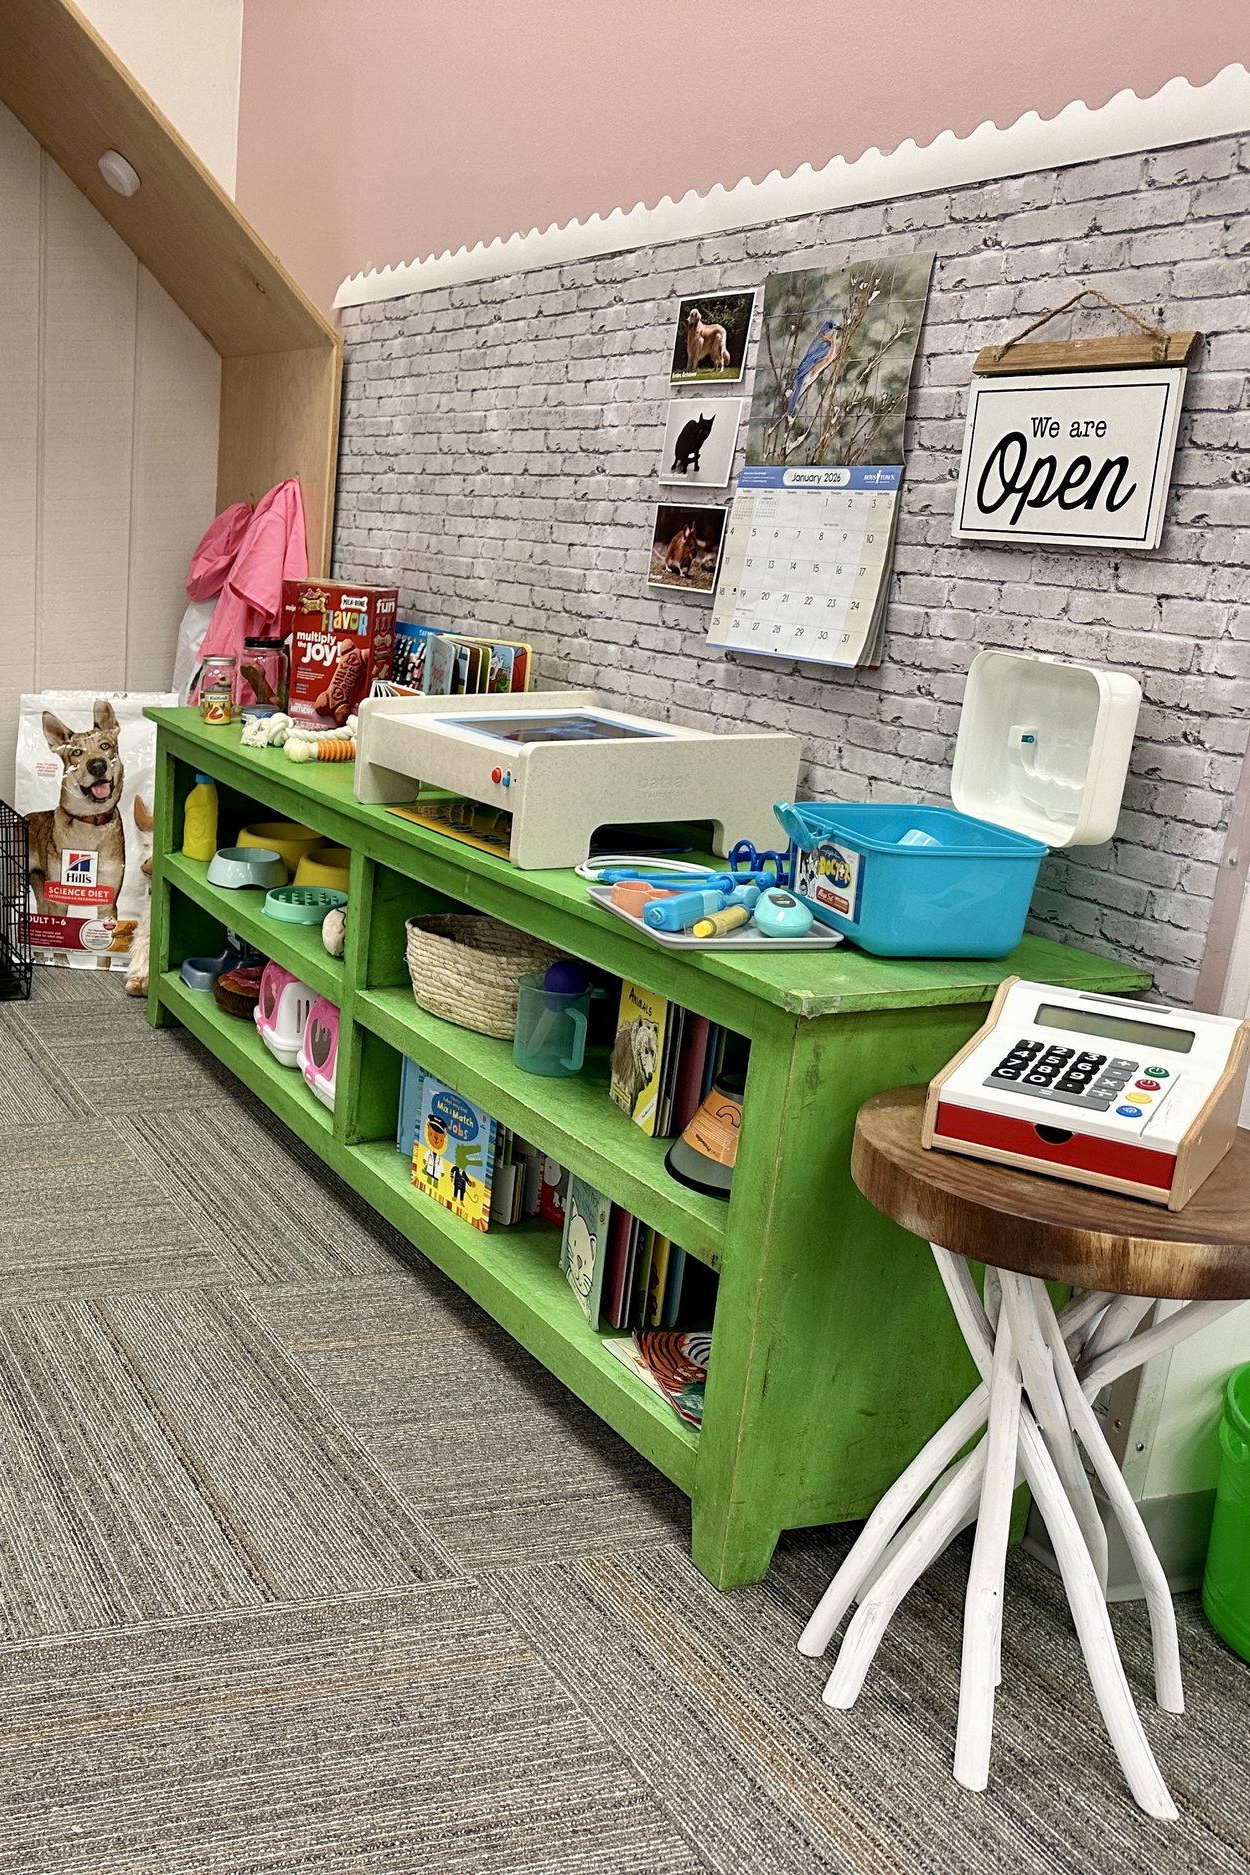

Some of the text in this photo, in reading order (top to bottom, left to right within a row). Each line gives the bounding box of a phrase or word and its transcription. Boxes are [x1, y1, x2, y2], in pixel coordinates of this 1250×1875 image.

[1031, 416, 1107, 438] We are
[791, 473, 842, 484] January 2026
[977, 431, 1137, 526] Open
[866, 534, 874, 544] 10
[768, 560, 775, 569] 13
[812, 563, 820, 573] 15
[835, 565, 842, 575] 16
[858, 567, 866, 577] 17
[376, 599, 396, 614] fun
[740, 589, 747, 598] 19
[761, 592, 770, 601] 20
[781, 593, 790, 603] 21
[803, 596, 813, 606] 22
[827, 598, 837, 608] 23
[850, 601, 861, 610] 24
[296, 631, 337, 645] multiply
[297, 640, 307, 648] the
[794, 627, 804, 637] 29
[817, 630, 828, 640] 30
[841, 633, 850, 643] 31
[333, 663, 349, 688] MILK
[342, 666, 359, 690] BONE
[66, 873, 92, 884] Hill's
[48, 886, 110, 898] SCIENCE DIET
[20, 914, 67, 926] DULT 1-6
[628, 987, 653, 1017] ANIMALS
[1026, 1040, 1100, 1061] 1 2 3
[1007, 1058, 1085, 1080] 7 8 9
[1014, 1050, 1093, 1071] 4 5 6
[998, 1068, 1046, 1083] C 0
[436, 1100, 449, 1114] Mix
[452, 1110, 474, 1128] Match
[447, 1120, 469, 1140] Jobs
